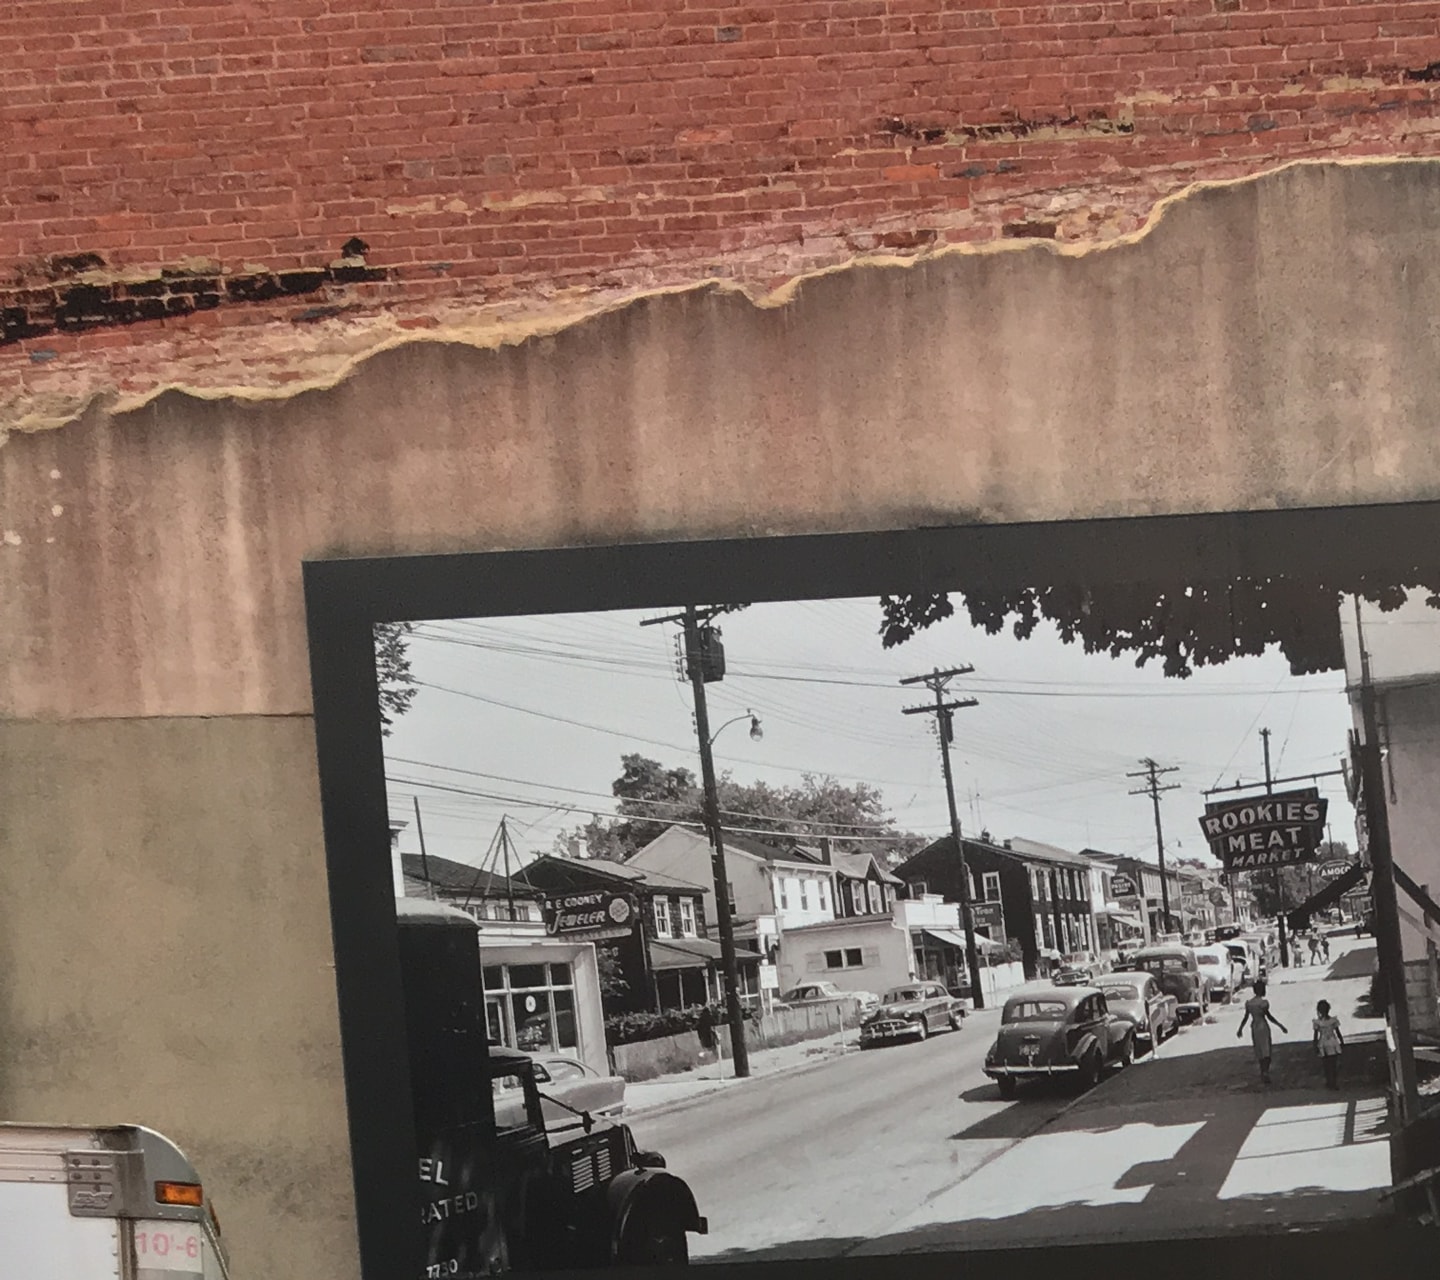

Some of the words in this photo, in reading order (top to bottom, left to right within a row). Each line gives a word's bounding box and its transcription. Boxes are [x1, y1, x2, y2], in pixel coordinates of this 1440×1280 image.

[1205, 803, 1320, 835] ROOKIES
[1228, 827, 1302, 852] MEAT
[1232, 847, 1305, 867] MARKET
